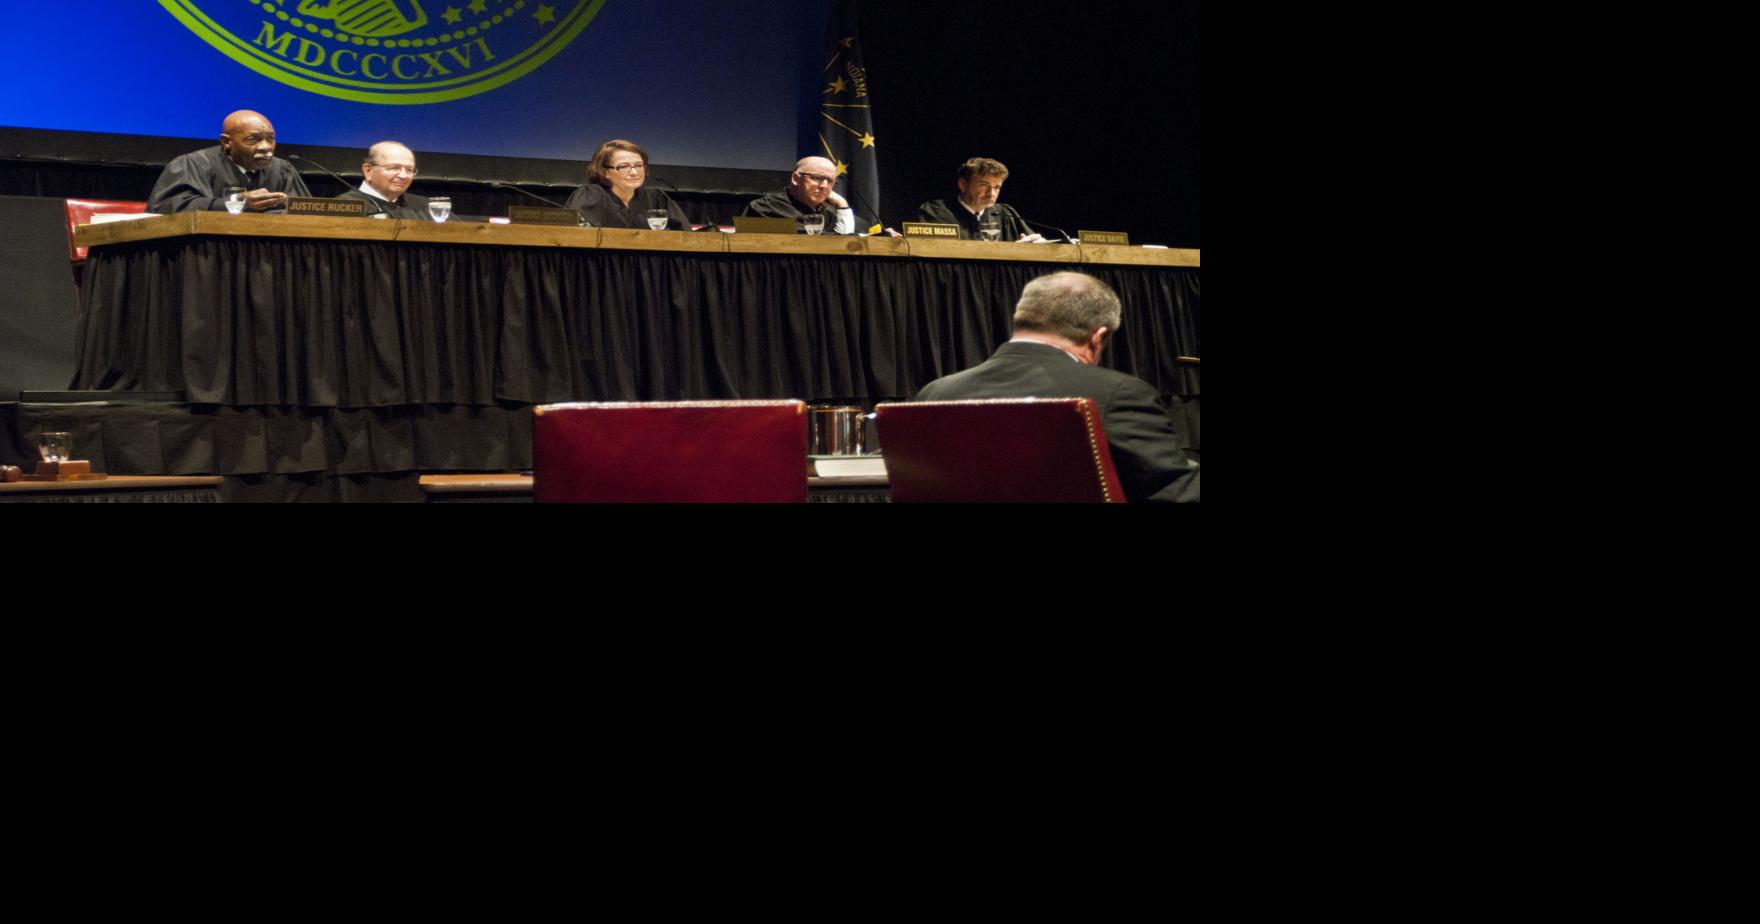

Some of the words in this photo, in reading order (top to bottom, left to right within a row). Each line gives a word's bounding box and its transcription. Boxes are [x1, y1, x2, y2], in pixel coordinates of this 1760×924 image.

[252, 20, 496, 80] MDCCCXVI
[290, 201, 326, 211] JUSTICE
[328, 203, 362, 212] RUCKER
[907, 226, 933, 235] JUSTICE
[934, 227, 957, 236] MASSA
